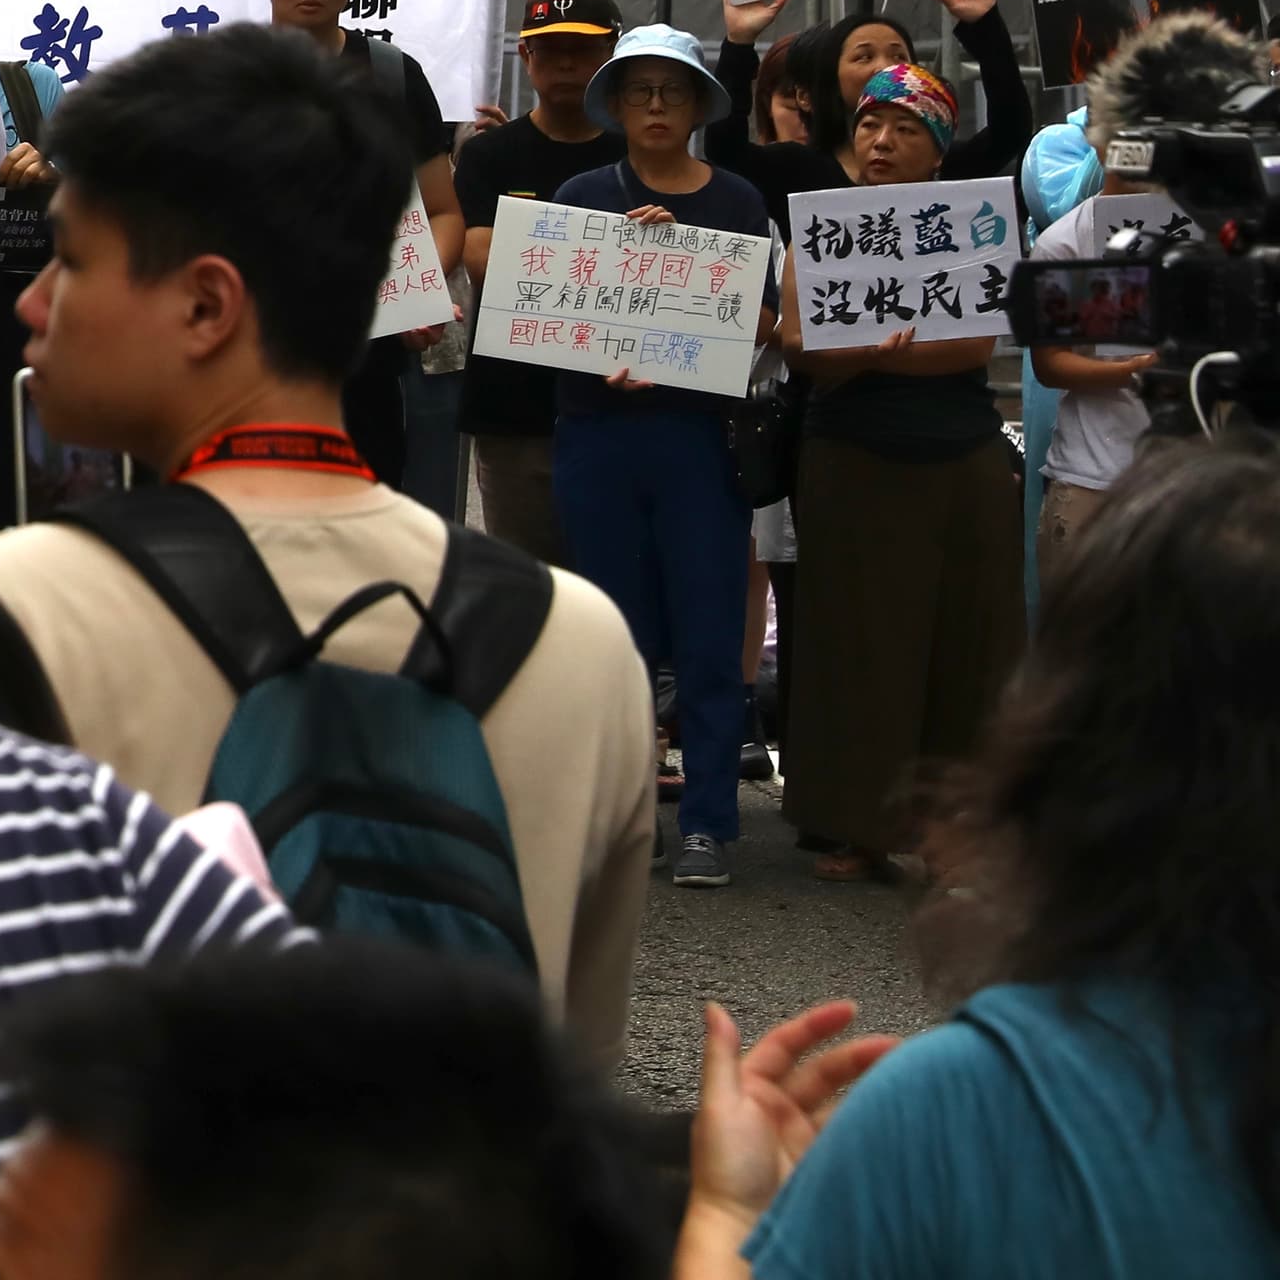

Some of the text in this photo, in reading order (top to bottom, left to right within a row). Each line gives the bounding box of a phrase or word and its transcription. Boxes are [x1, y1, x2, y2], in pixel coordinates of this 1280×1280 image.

[801, 200, 1007, 263] 抗議藍白
[809, 264, 1008, 326] 沒收民主
